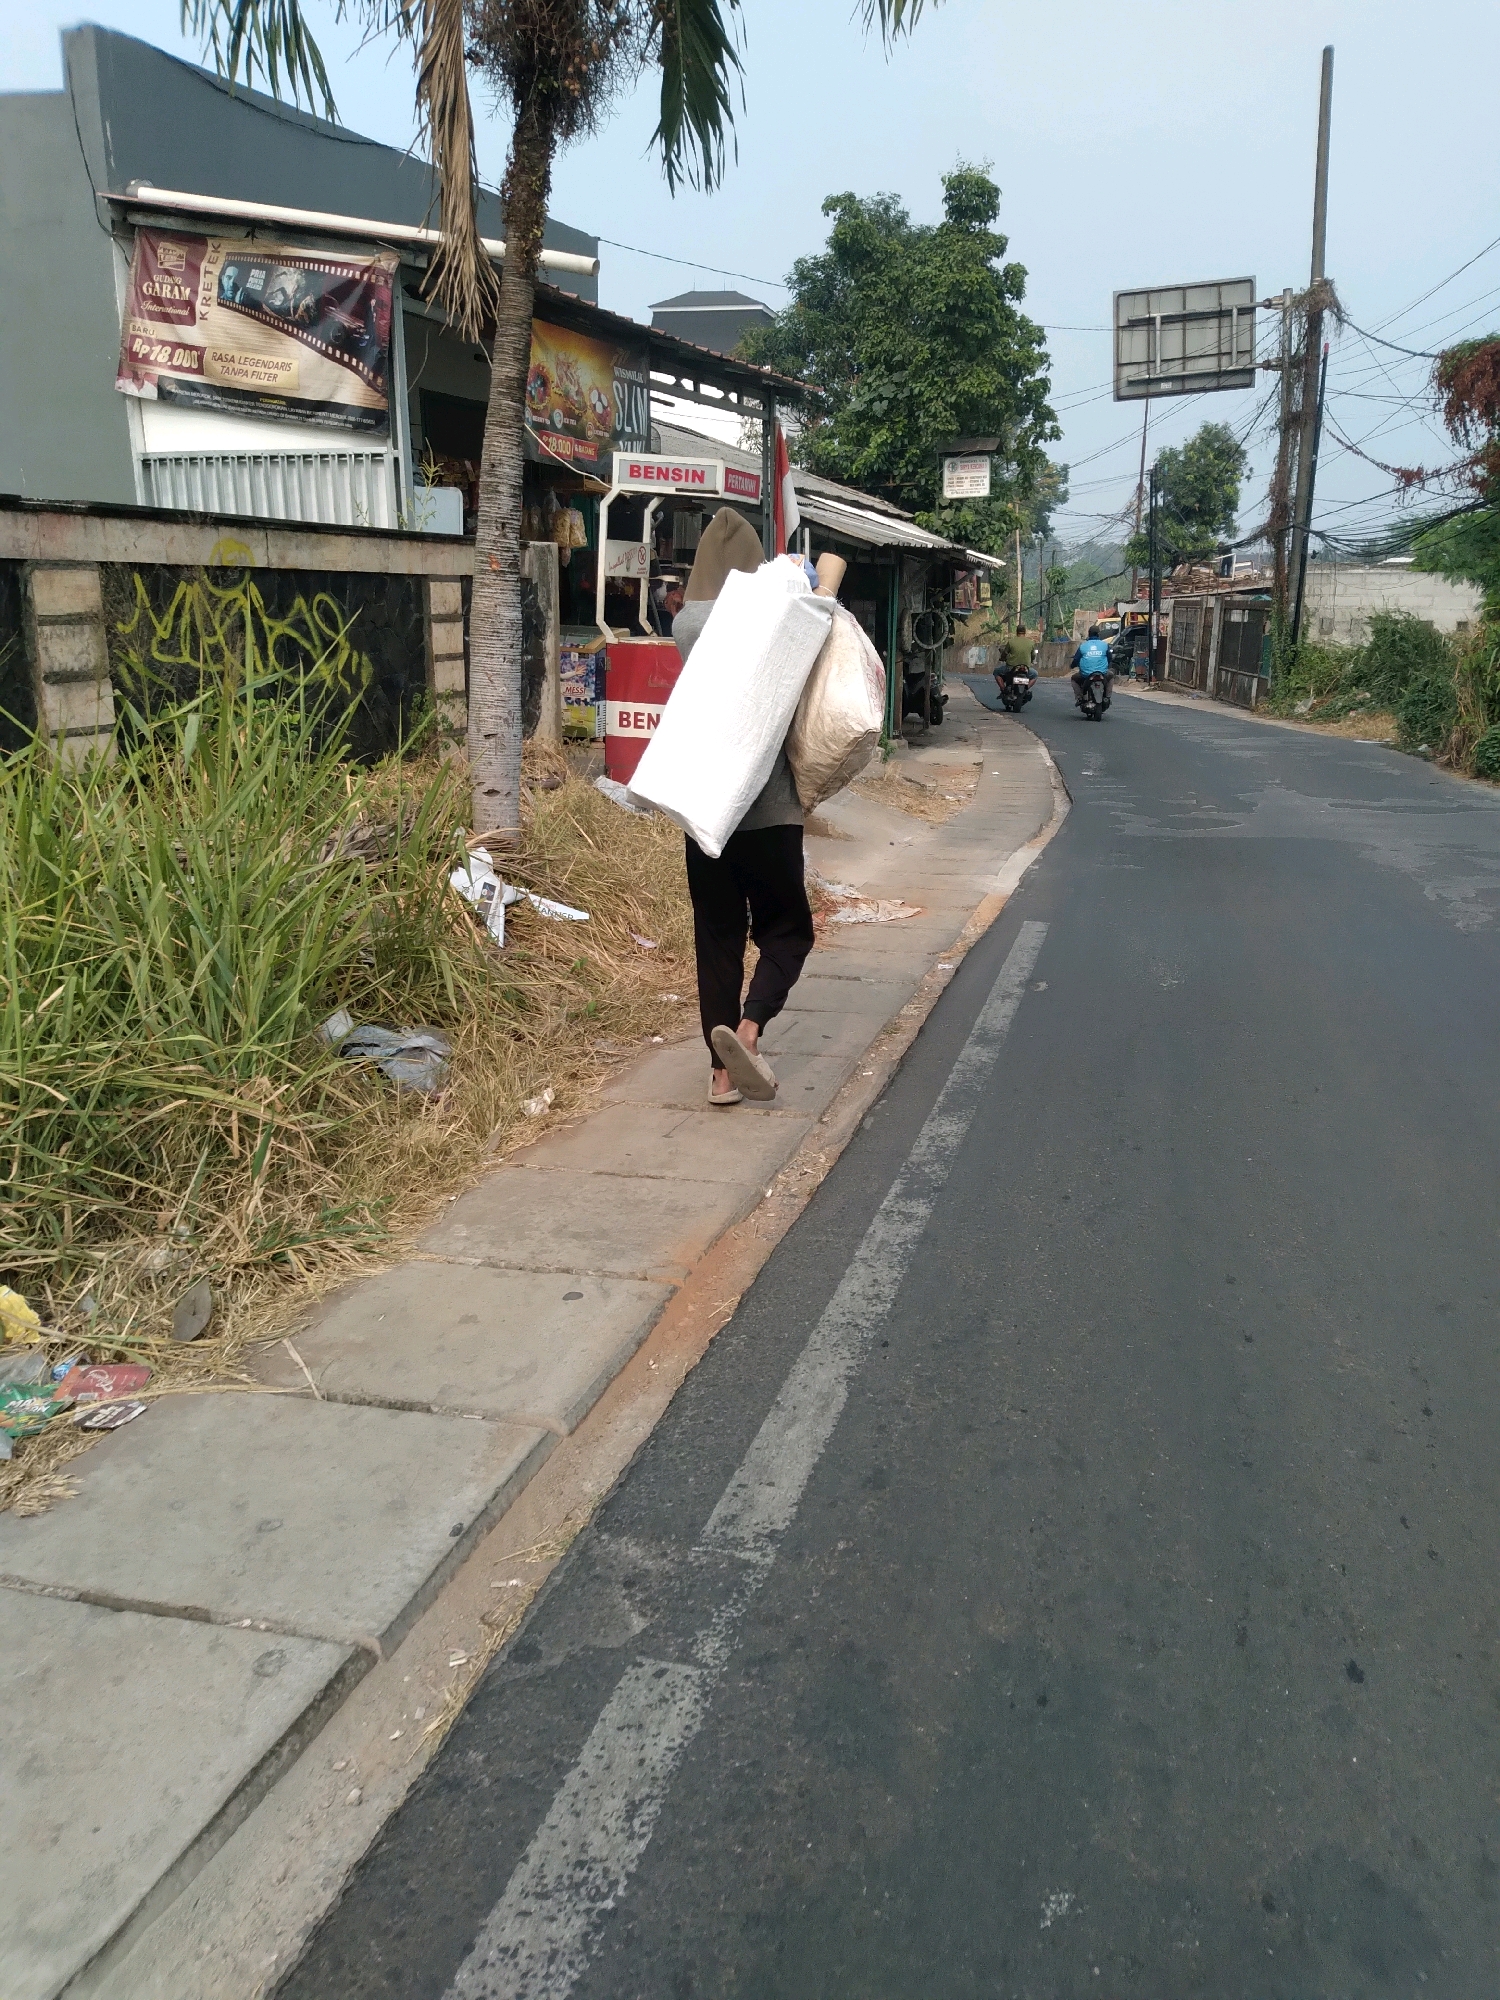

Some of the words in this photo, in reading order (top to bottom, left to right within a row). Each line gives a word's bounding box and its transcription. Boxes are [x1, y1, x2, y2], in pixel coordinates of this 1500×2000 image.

[153, 274, 183, 284] GUDANG
[199, 242, 222, 321] KRETEK
[142, 281, 191, 301] GARAM
[141, 300, 190, 316] International
[131, 324, 155, 336] BARU
[211, 352, 236, 364] RASA
[238, 355, 293, 372] LEGENDARIS
[220, 366, 249, 378] TANPA
[250, 370, 278, 383] FILTER
[613, 366, 644, 384] WISMILAK
[613, 380, 648, 437] SLIM
[629, 464, 706, 484] BENSIN
[563, 686, 586, 694] MESSI
